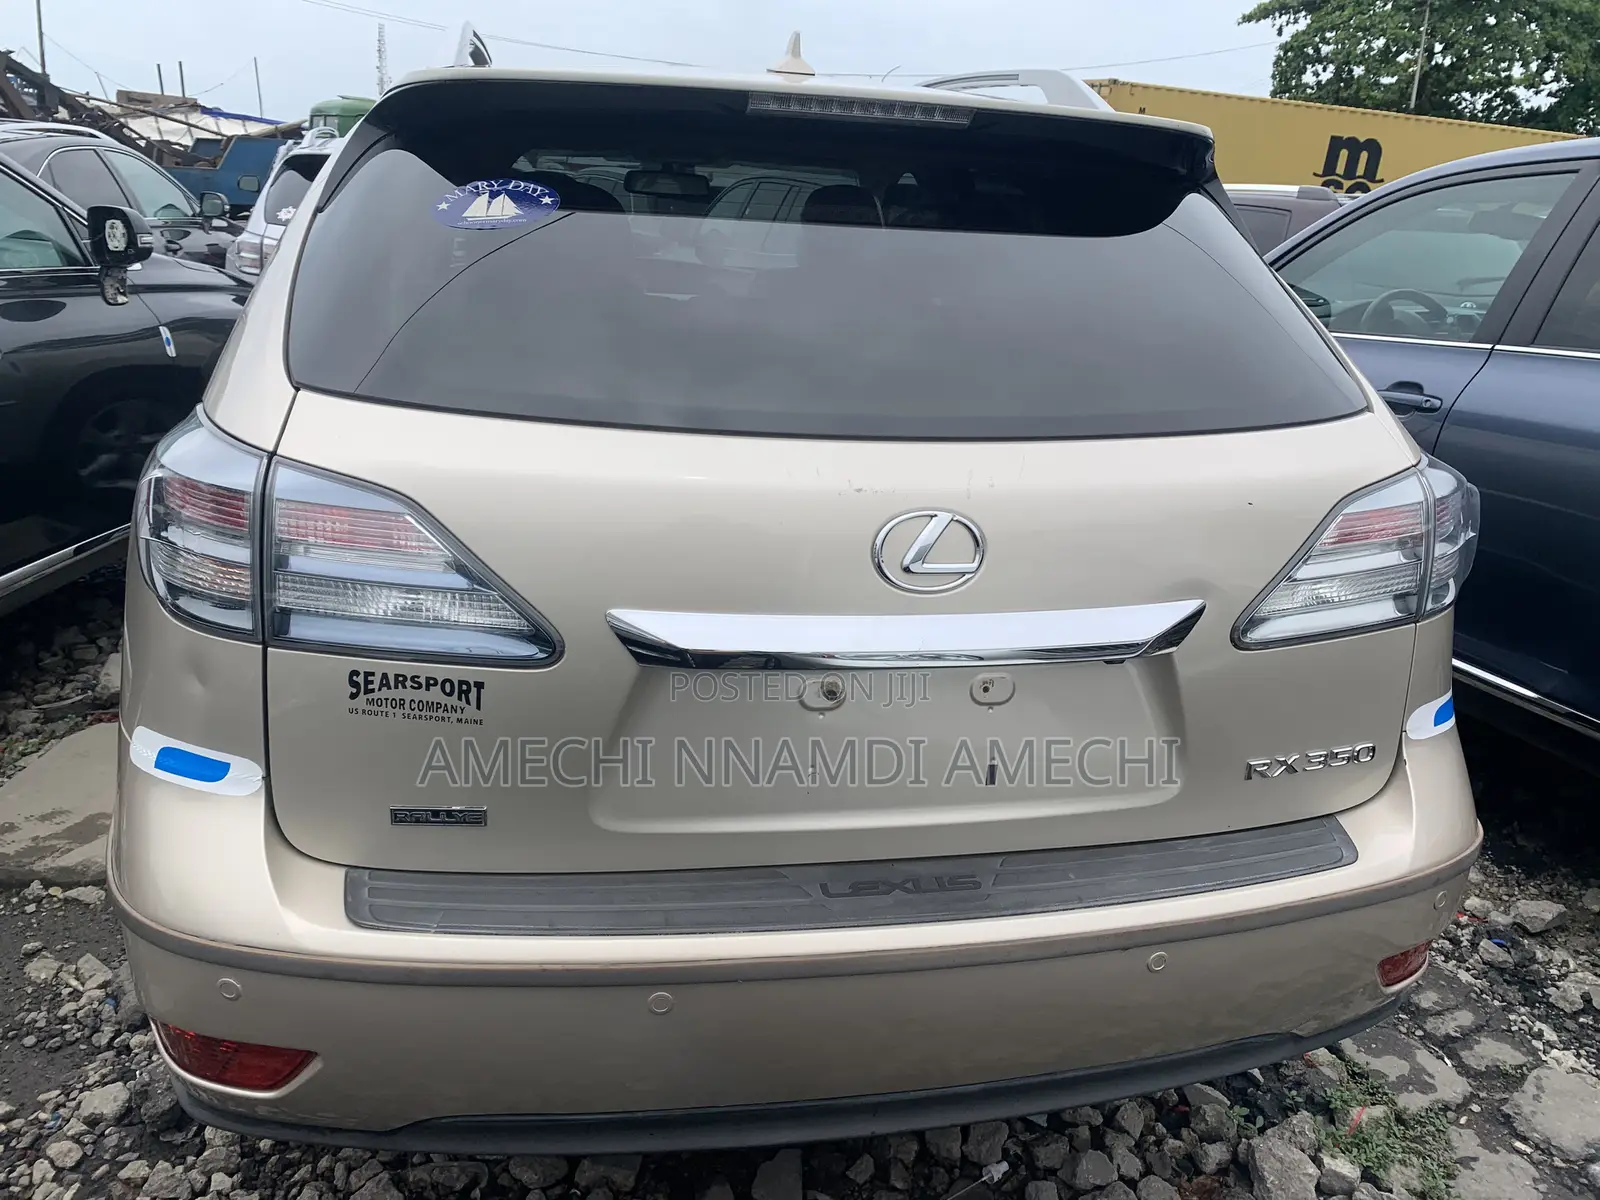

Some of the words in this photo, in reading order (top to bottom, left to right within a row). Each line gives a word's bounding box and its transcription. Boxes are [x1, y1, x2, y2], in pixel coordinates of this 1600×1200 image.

[444, 179, 504, 202] MARY
[508, 179, 550, 197] DAY
[348, 669, 485, 711] SEARSPORT
[348, 707, 360, 715] US
[361, 708, 390, 718] ROUTE
[401, 712, 454, 724] SEARSPORT,
[456, 717, 484, 726] MAINE
[365, 697, 406, 711] MOTOR
[409, 699, 466, 714] COMPANY
[1244, 753, 1300, 780] RX
[1302, 741, 1377, 772] 350
[393, 811, 483, 822] RALLYE
[818, 874, 983, 899] LEXUS
